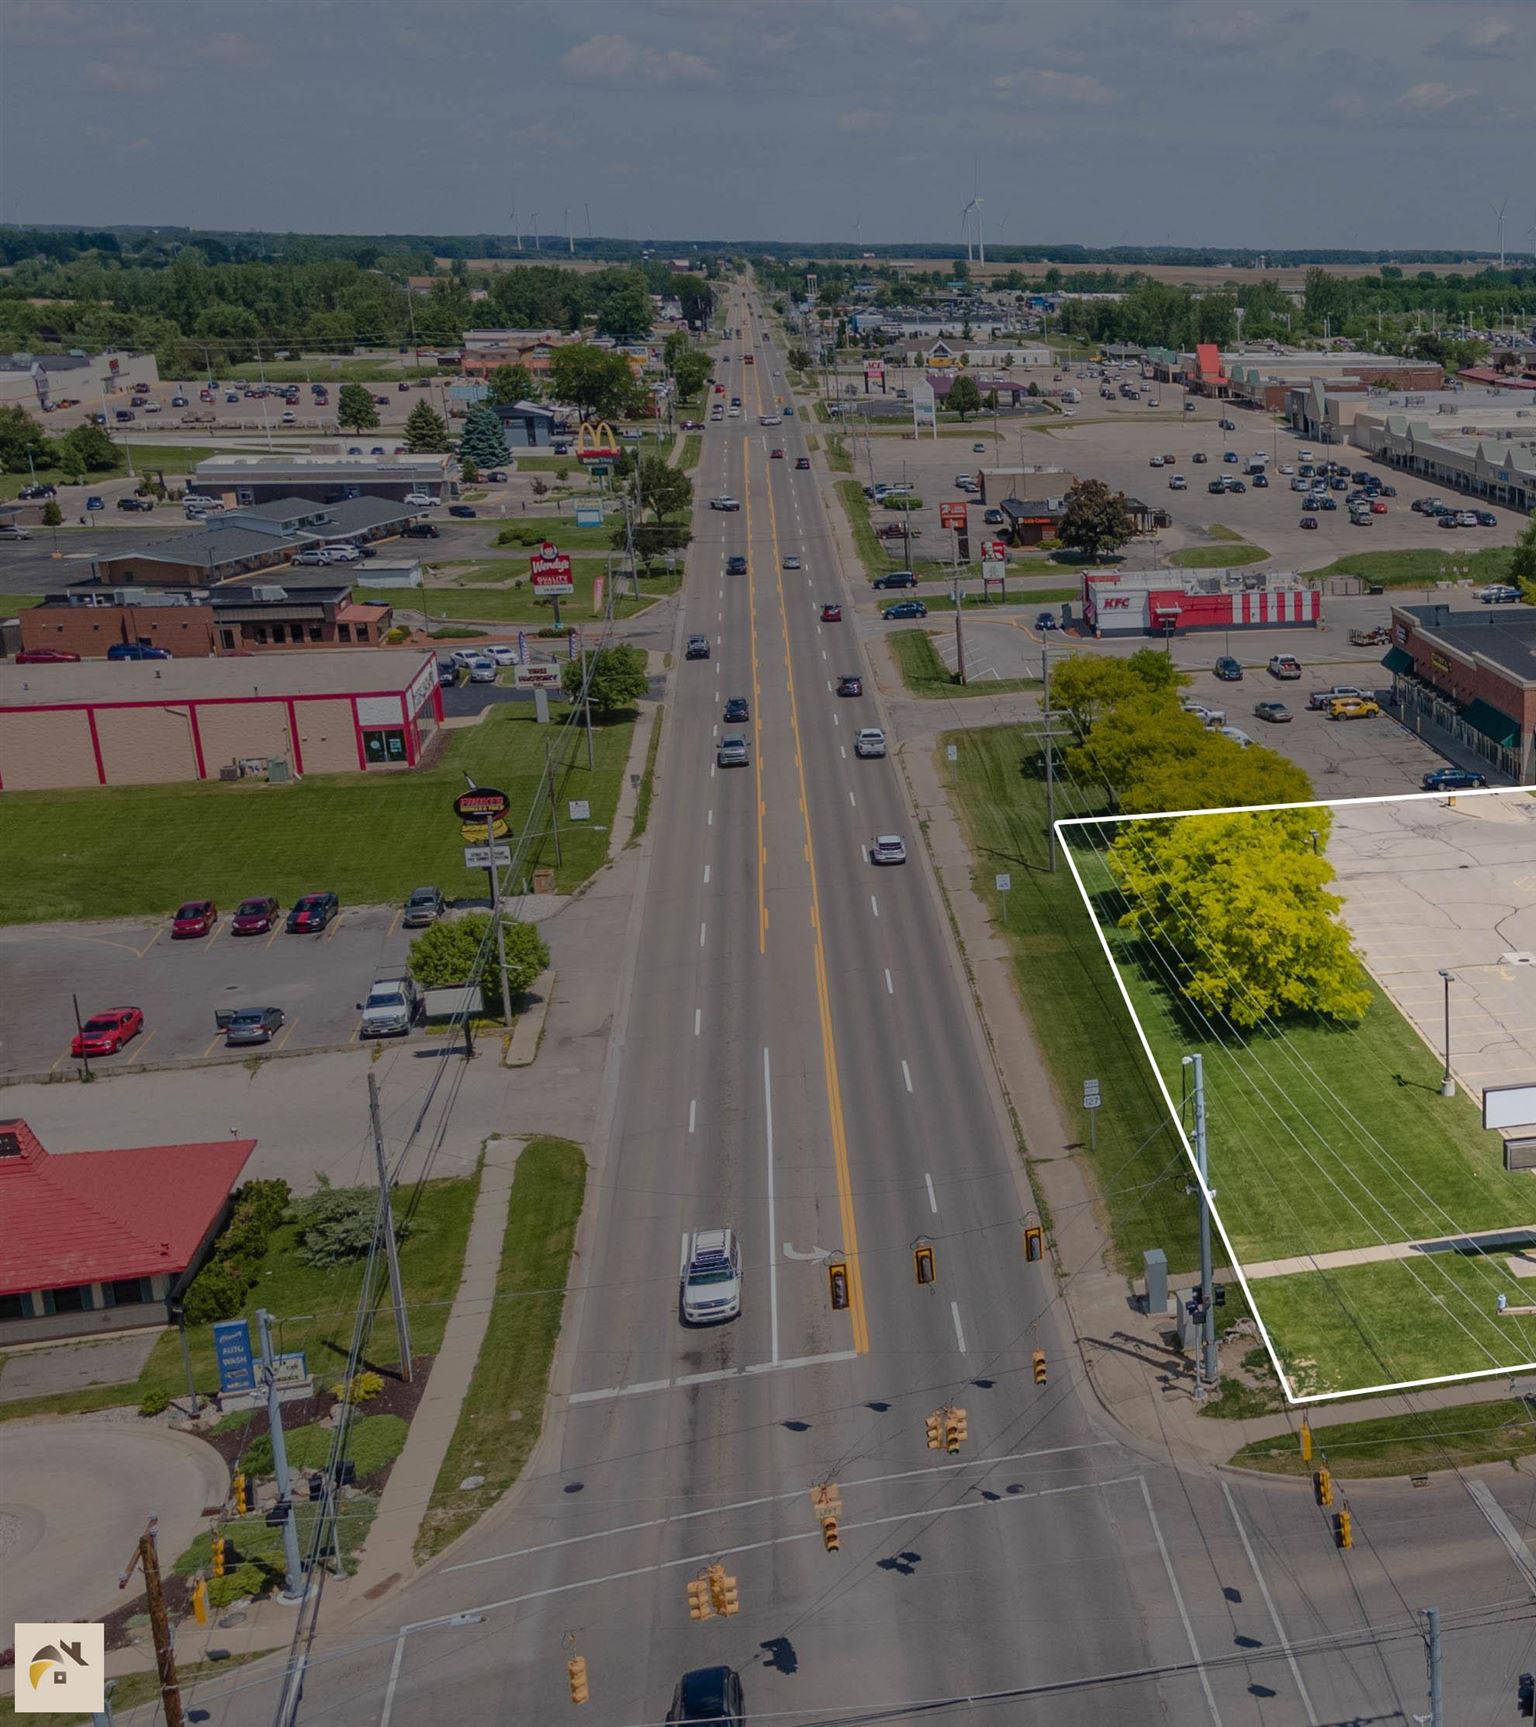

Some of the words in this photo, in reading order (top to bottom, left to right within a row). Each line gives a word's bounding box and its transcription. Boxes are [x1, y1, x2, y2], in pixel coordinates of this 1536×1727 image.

[866, 361, 882, 369] ACE
[1103, 597, 1130, 609] KFC
[223, 1345, 244, 1355] AUTO
[222, 1355, 247, 1367] WASH
